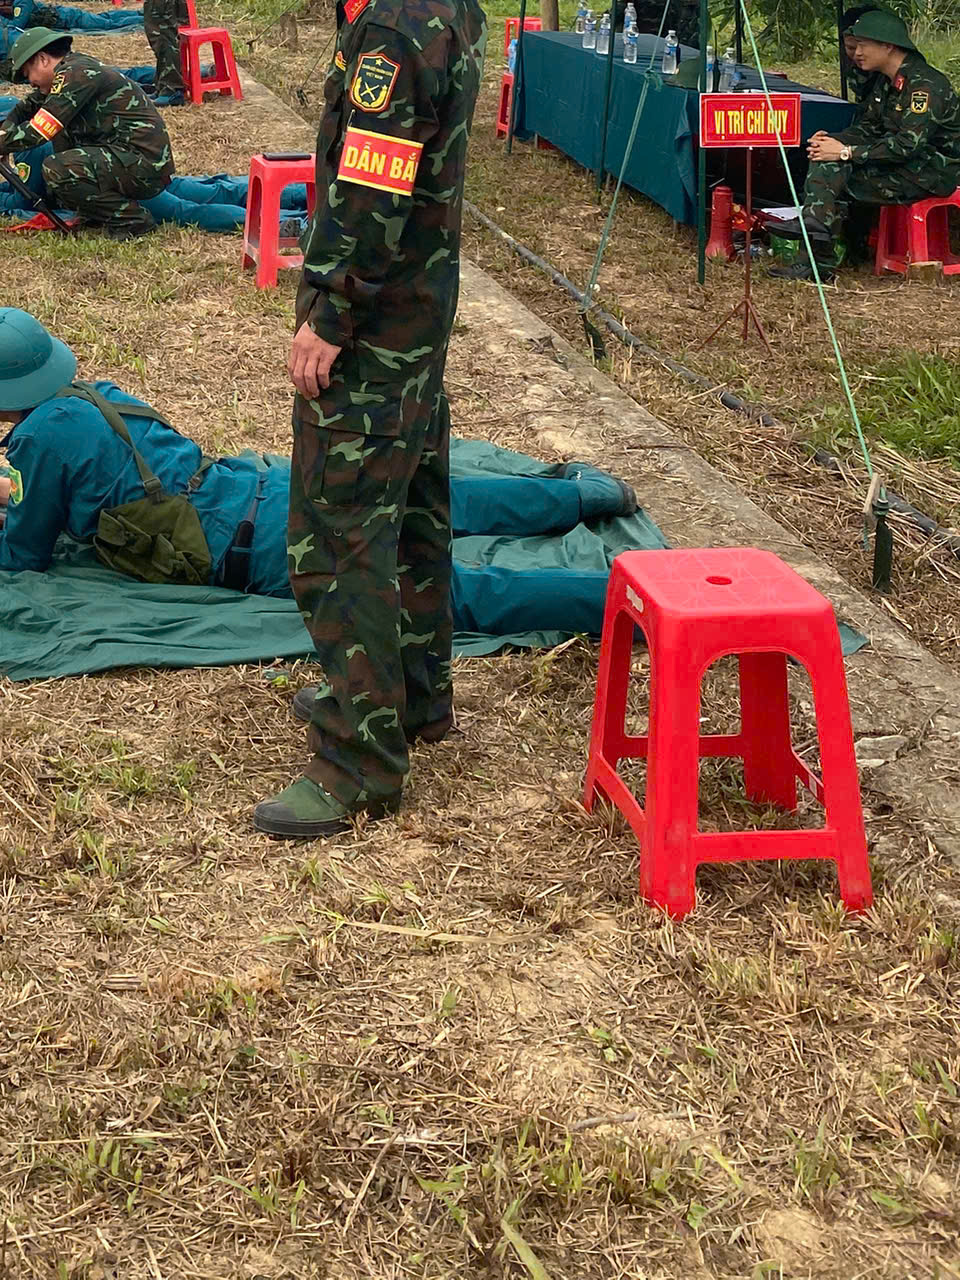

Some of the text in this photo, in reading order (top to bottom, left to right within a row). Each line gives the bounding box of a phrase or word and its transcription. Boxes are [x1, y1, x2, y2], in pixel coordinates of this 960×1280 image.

[714, 102, 789, 140] VỊ TRÍ CHỈ HUY
[343, 141, 419, 183] DẪN BẮ
